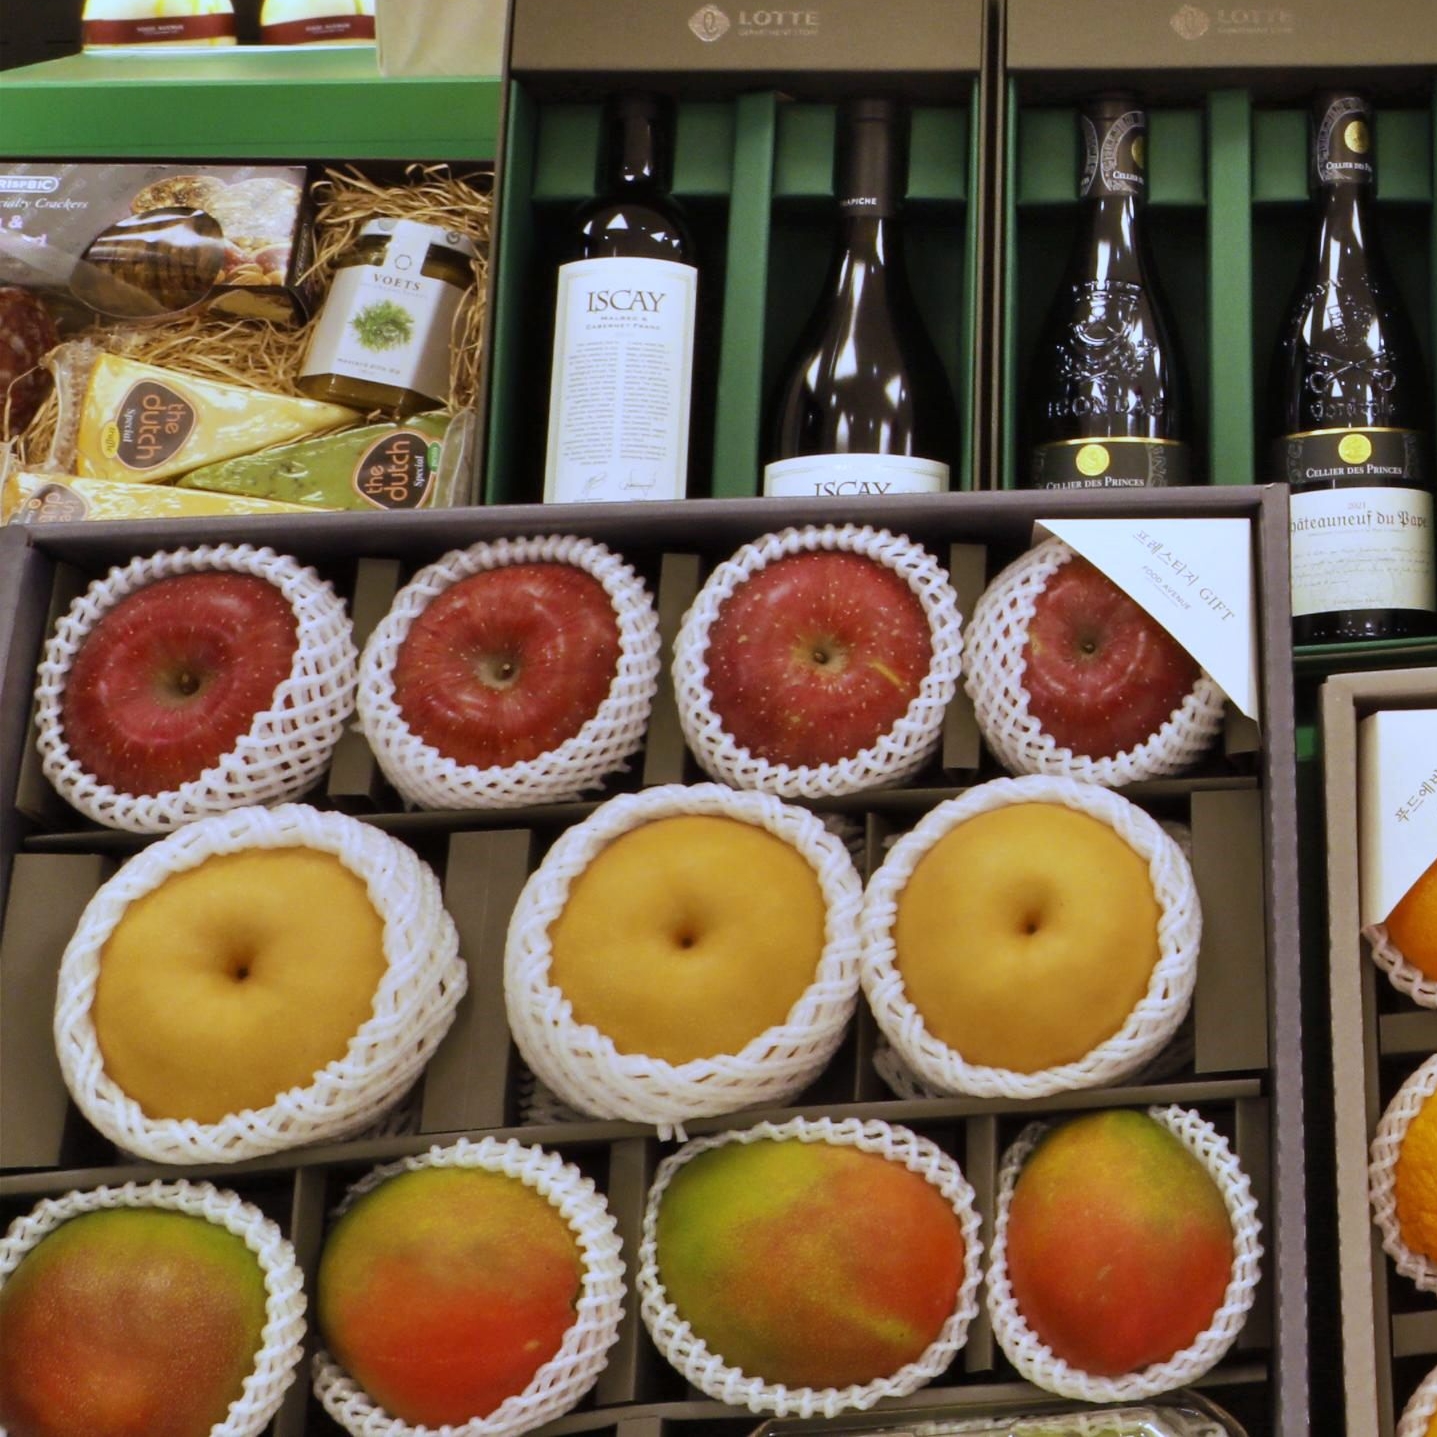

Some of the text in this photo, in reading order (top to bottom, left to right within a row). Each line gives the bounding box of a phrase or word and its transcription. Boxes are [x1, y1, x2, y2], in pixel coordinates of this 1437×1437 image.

[738, 10, 820, 26] LOTTE
[35, 196, 89, 211] Crackers
[373, 273, 421, 291] VOETS
[586, 289, 667, 313] ISCAY
[122, 408, 137, 443] Special
[136, 394, 168, 460] dutch
[164, 403, 186, 435] the
[363, 464, 385, 494] the
[383, 440, 411, 502] dutch
[413, 454, 426, 488] Special
[1084, 479, 1102, 487] DES
[1104, 475, 1145, 487] PRINCES
[1306, 463, 1404, 479] CELLIER DES PRINCES
[1377, 511, 1395, 524] du
[1397, 510, 1428, 528] Pape
[1132, 529, 1236, 621] 프레스티지 GIFT
[1141, 565, 1192, 610] FOOD AVENUE
